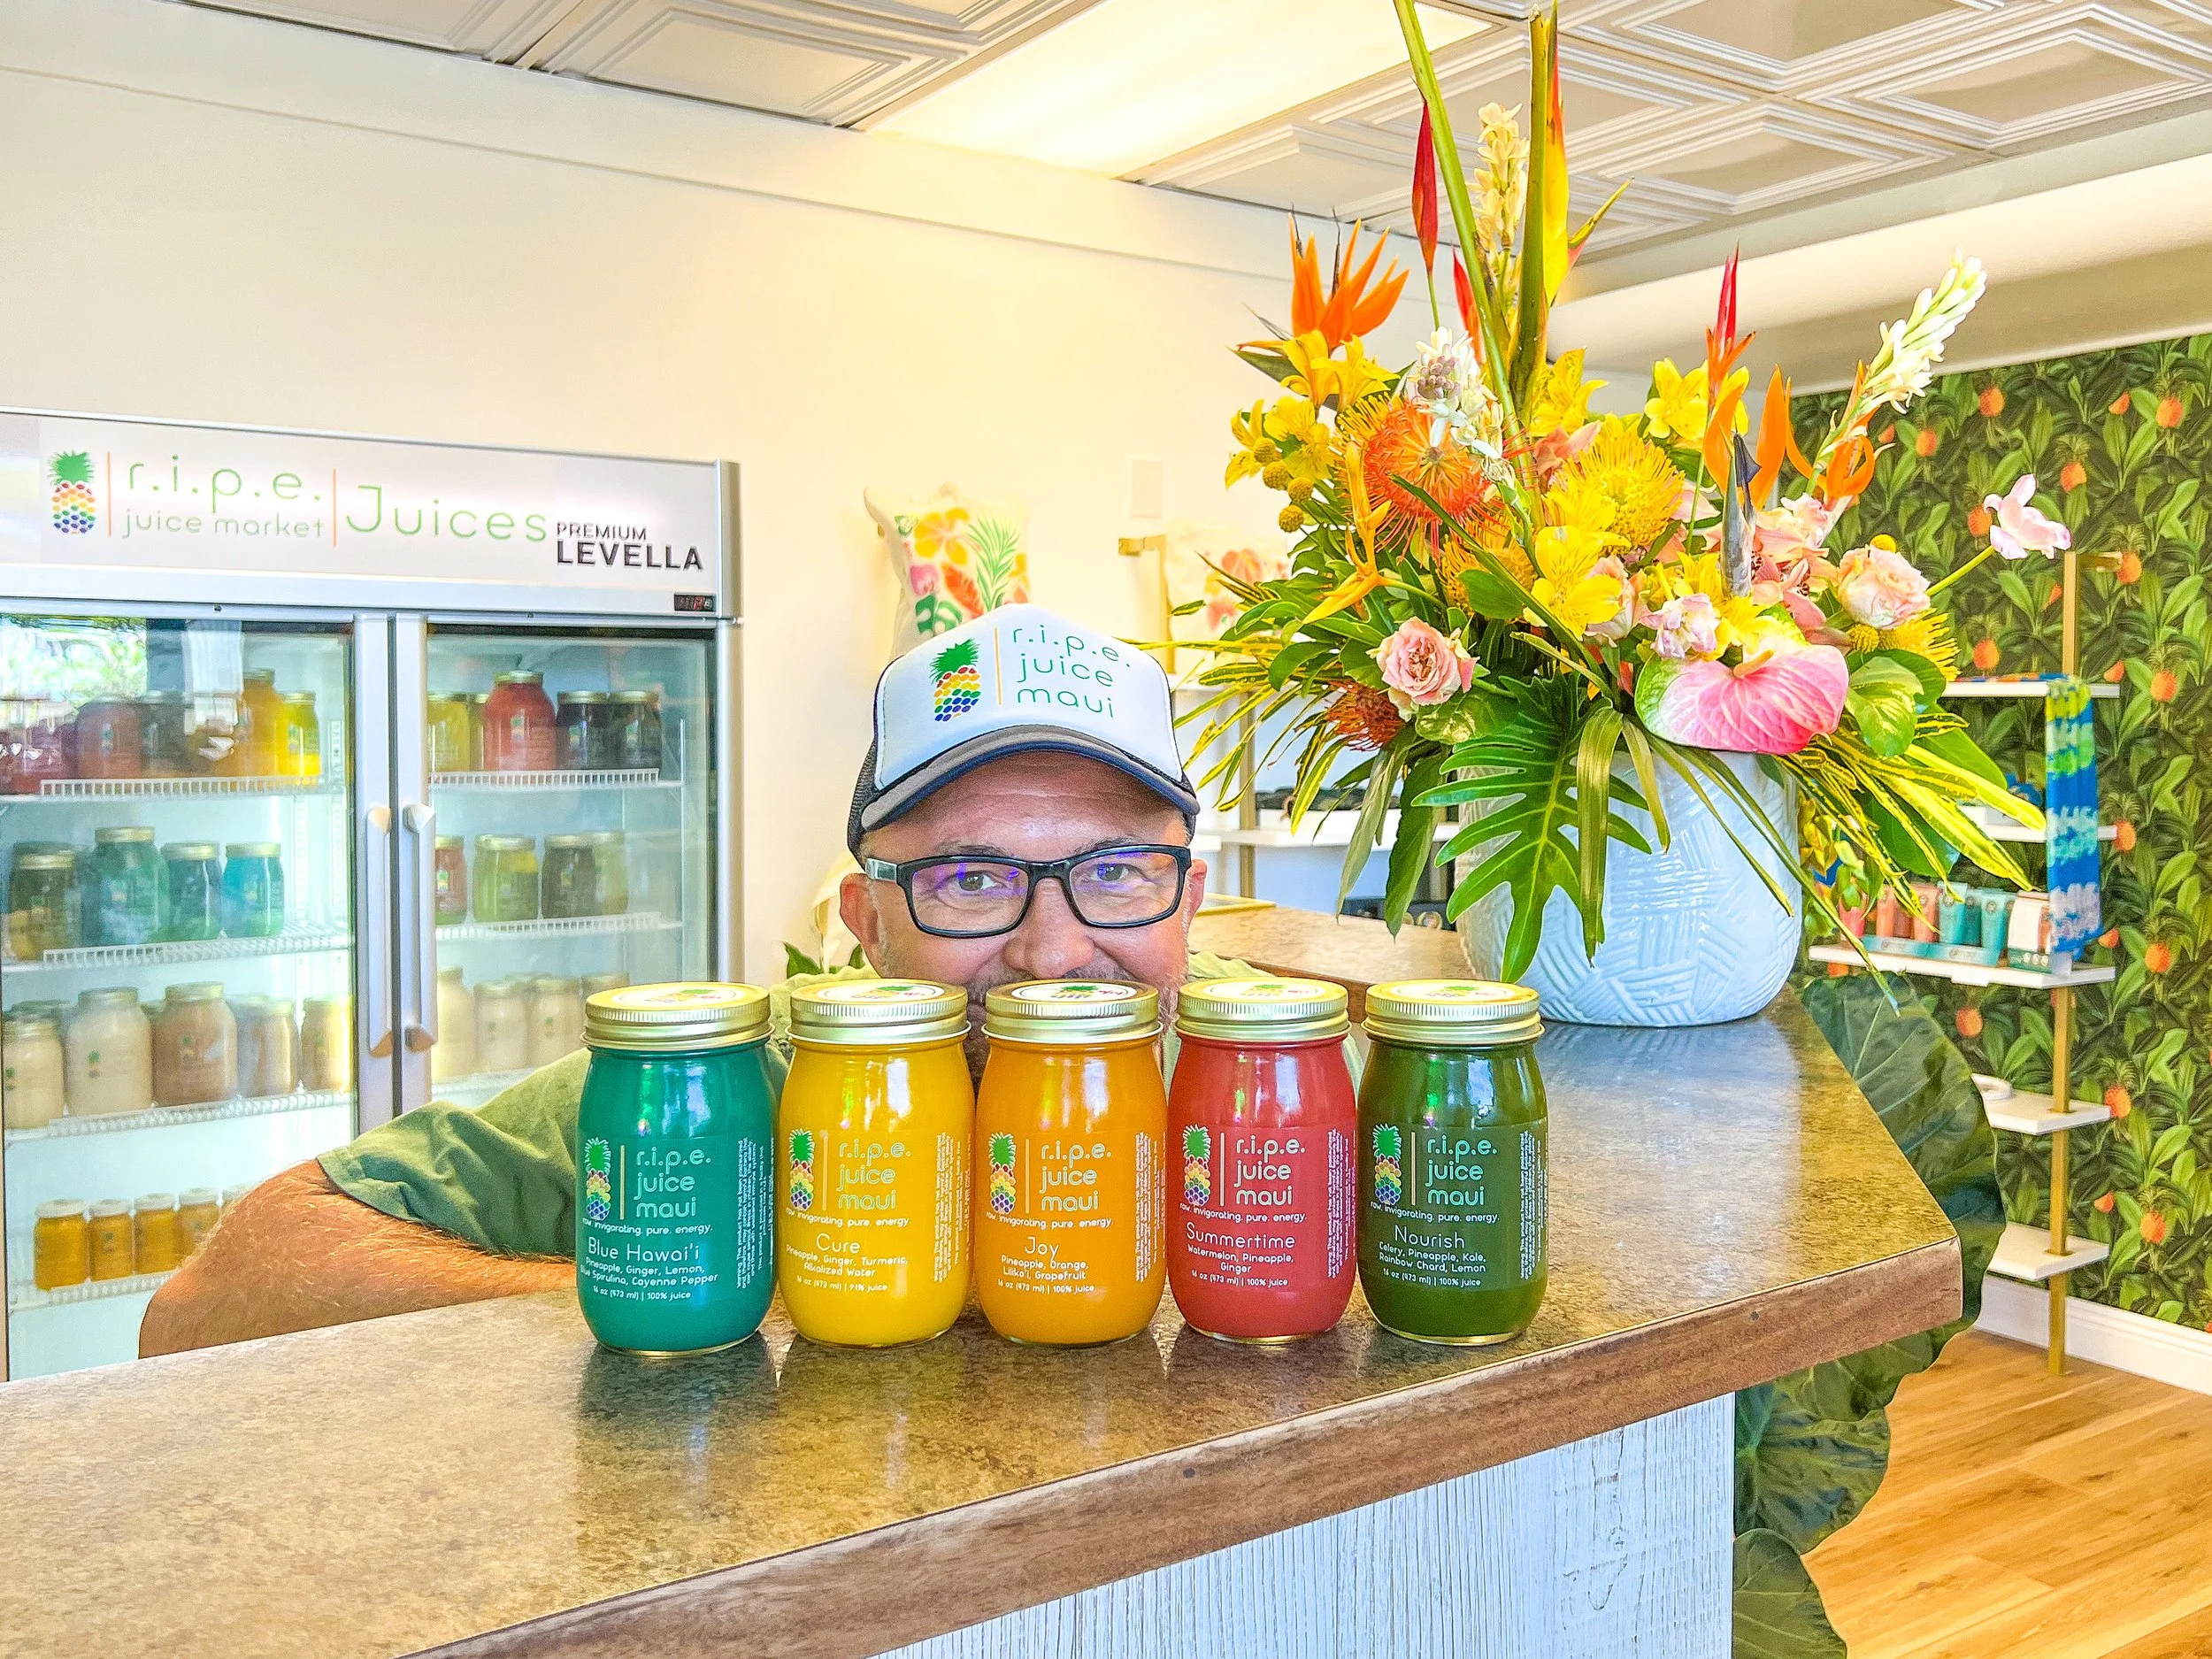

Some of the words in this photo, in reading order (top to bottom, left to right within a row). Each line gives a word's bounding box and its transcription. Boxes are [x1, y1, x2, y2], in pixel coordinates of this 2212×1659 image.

[130, 454, 320, 513] r.i.p.e.
[122, 509, 202, 539] juice
[214, 511, 324, 538] market
[346, 484, 548, 543] Juices
[556, 521, 647, 541] PREMIUM
[556, 539, 704, 571] LEVELLA
[1013, 625, 1131, 667] r.i.p.e.
[1017, 653, 1113, 687] juice
[1017, 688, 1114, 718] maui
[840, 1139, 911, 1166] r.i.p.e.
[1041, 1140, 1111, 1168] r.i.p.e.
[1236, 1134, 1306, 1164] r.i.p.e.
[1426, 1134, 1498, 1164] r.i.p.e.
[636, 1147, 711, 1174] r.i.p.e.
[836, 1164, 895, 1192] juice
[1039, 1166, 1097, 1194] juice
[1233, 1160, 1292, 1187] juice
[1425, 1159, 1484, 1187] juice
[633, 1172, 695, 1200] juice
[1236, 1185, 1293, 1206] maui
[1427, 1186, 1485, 1206] maui
[635, 1196, 696, 1218] maui
[838, 1190, 896, 1210] maui
[1041, 1190, 1099, 1212] maui
[1193, 1207, 1243, 1223] invigorating.
[1246, 1213, 1270, 1224] pure.
[1273, 1213, 1307, 1223] energy.
[1384, 1204, 1434, 1222] invigorating.
[1438, 1213, 1462, 1223] pure.
[1465, 1213, 1500, 1224] energy.
[816, 1233, 861, 1254] Cure
[1187, 1222, 1295, 1248] Summertime
[1394, 1224, 1465, 1248] Nourish
[588, 1236, 618, 1260] Blue
[1025, 1236, 1059, 1261] Joy
[1187, 1244, 1239, 1263] Watermelon,
[1242, 1253, 1294, 1265] Pineapple,
[1379, 1240, 1405, 1256] Celery,
[1408, 1248, 1459, 1263] Pineapple,
[1463, 1252, 1486, 1263] Kale,
[585, 1256, 623, 1274] Pineapple,
[626, 1265, 662, 1277] Ginger,
[665, 1265, 705, 1275] Lemon,
[804, 1262, 843, 1276] Alkalized
[847, 1267, 877, 1277] Water
[824, 1255, 856, 1267] Ginger,
[861, 1256, 909, 1265] Turmeric,
[1001, 1255, 1046, 1270] Pineapple,
[1050, 1260, 1089, 1271] Orange,
[1220, 1262, 1251, 1274] Ginger
[1379, 1252, 1413, 1268] Rainbow
[1417, 1260, 1448, 1273] Chard,
[1451, 1263, 1486, 1273] Lemon
[592, 1271, 629, 1286] Spirulina,
[632, 1276, 677, 1288] Cayenne
[680, 1273, 718, 1286] Pepper
[1034, 1271, 1086, 1281] Grapefruit
[1226, 1277, 1239, 1286] ml)
[1268, 1278, 1288, 1287] juice
[1419, 1276, 1432, 1285] ml)
[1440, 1277, 1459, 1286] 100%
[1461, 1278, 1481, 1287] juice
[670, 1292, 691, 1301] juice
[867, 1284, 888, 1293] juice
[1074, 1285, 1094, 1294] juice
